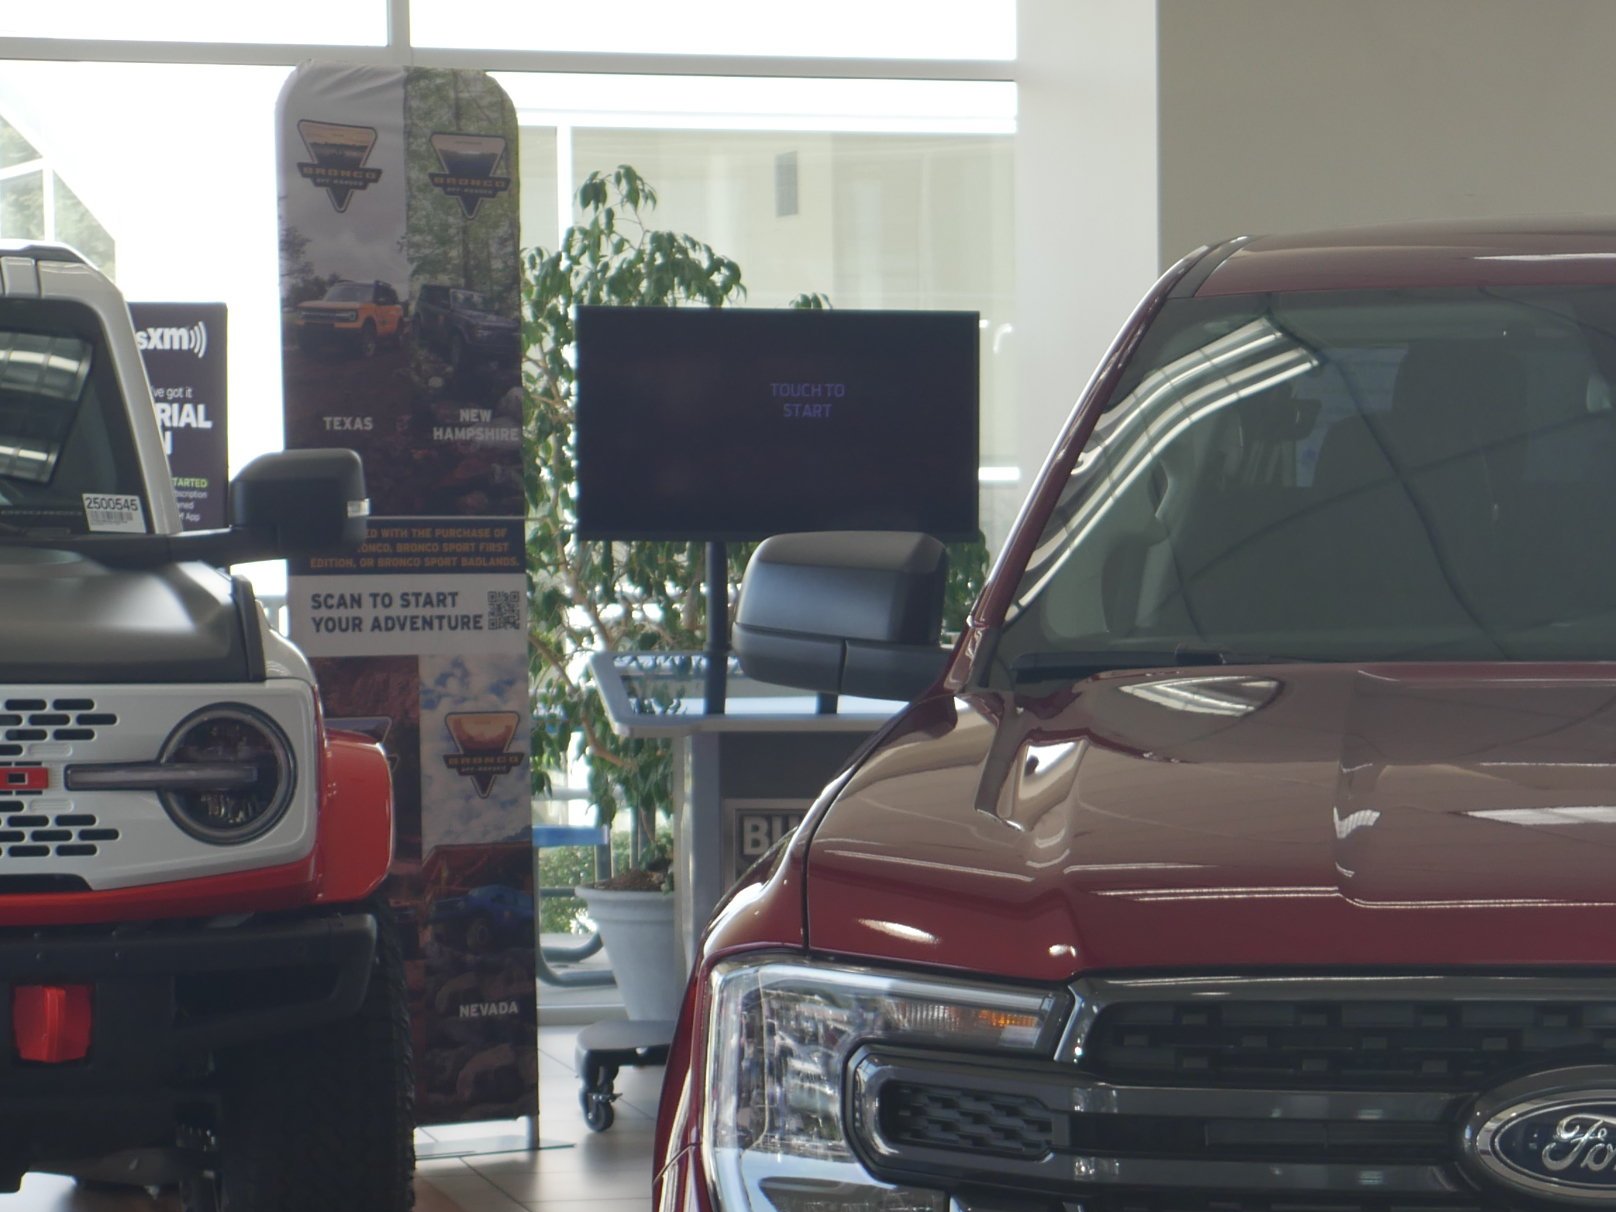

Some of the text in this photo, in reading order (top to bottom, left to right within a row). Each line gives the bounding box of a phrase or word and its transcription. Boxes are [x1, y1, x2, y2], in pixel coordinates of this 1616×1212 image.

[166, 387, 183, 400] got
[186, 386, 193, 398] it
[770, 383, 845, 398] TOUCH TO
[459, 409, 492, 422] NEW
[783, 403, 832, 417] START
[323, 416, 374, 430] TEXAS
[433, 427, 519, 441] HAMPSHIRE
[85, 497, 138, 511] 2500545
[381, 528, 408, 538] WITH
[412, 528, 432, 538] THE
[435, 528, 490, 538] PURCHASE
[494, 528, 508, 538] OF
[397, 543, 438, 553] BRONCO
[442, 543, 475, 553] SPORT
[479, 543, 509, 553] FIRST
[360, 558, 374, 568] OR
[378, 558, 420, 568] BRONCO
[424, 557, 458, 567] SPORT
[461, 557, 519, 567] BADLANDS.
[311, 591, 458, 610] SCAN TO START
[312, 614, 483, 633] YOUR ADVENTURE
[459, 1001, 518, 1017] NEVADA
